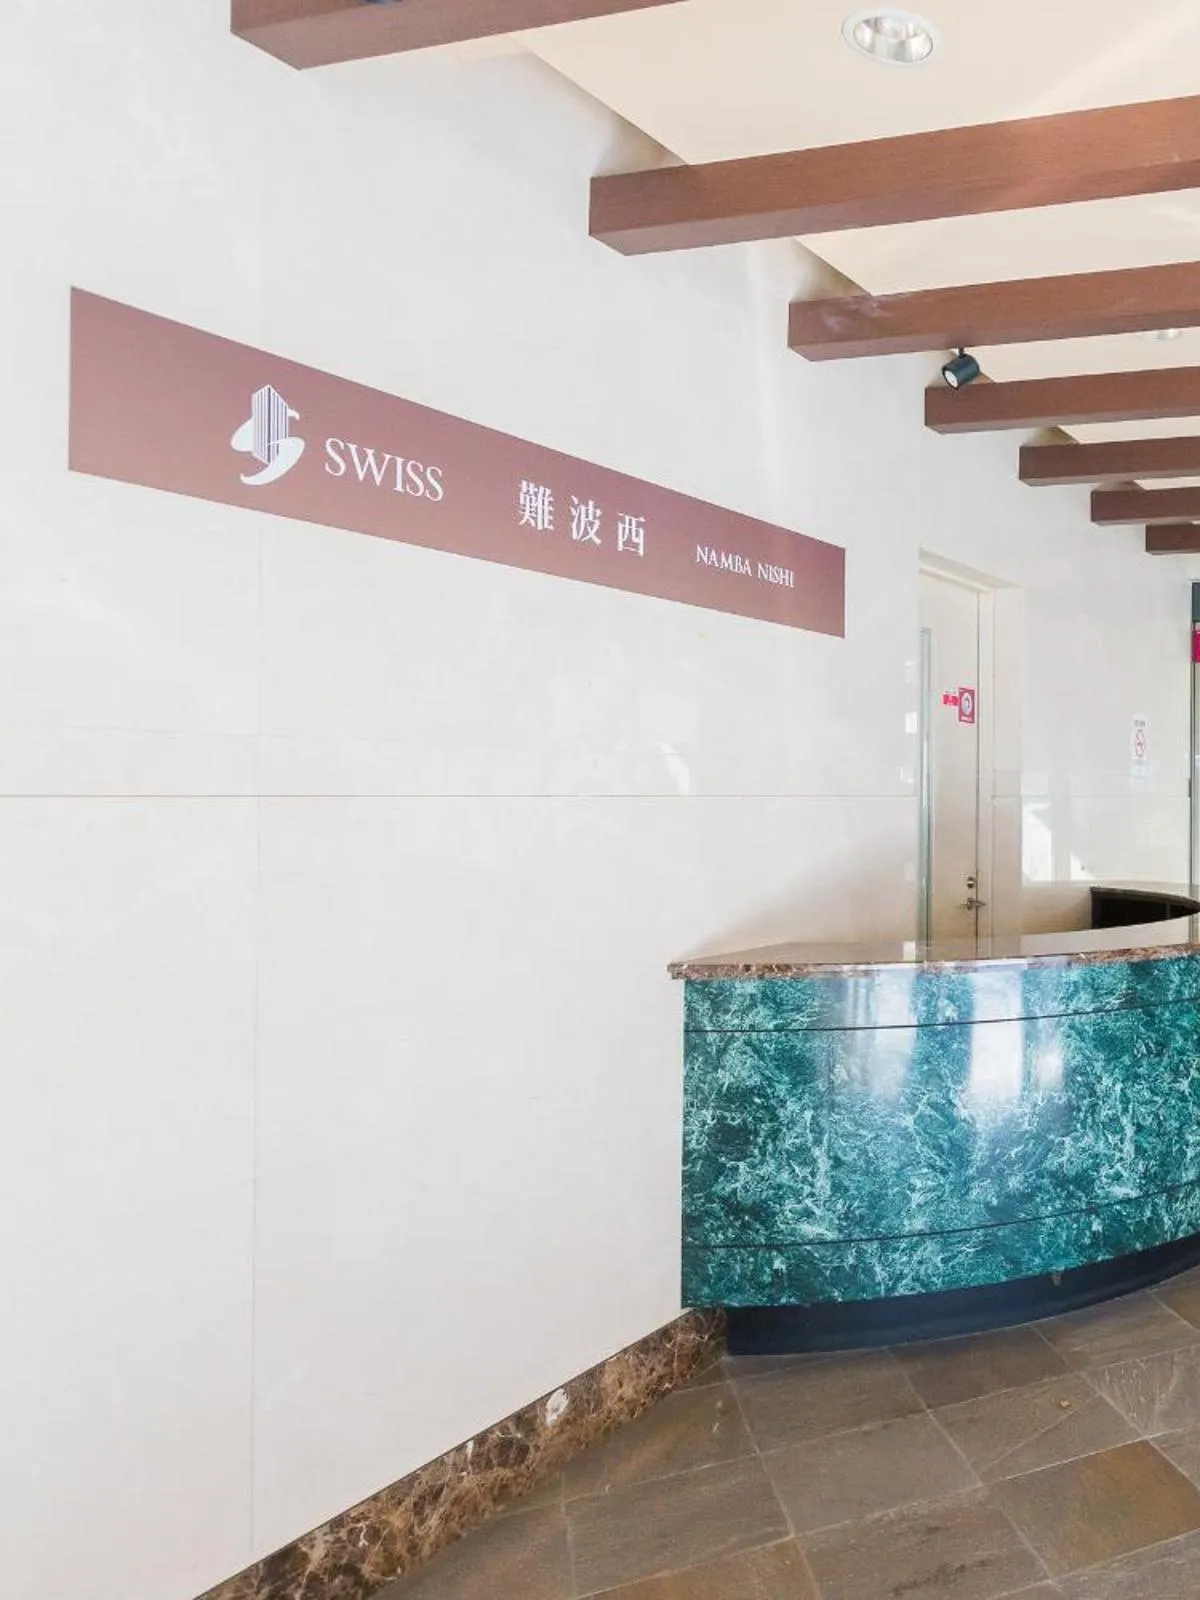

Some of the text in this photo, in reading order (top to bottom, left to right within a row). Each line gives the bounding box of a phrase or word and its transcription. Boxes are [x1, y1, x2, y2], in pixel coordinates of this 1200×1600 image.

[324, 437, 444, 502] SWISS
[518, 479, 647, 557] 難波西
[696, 544, 795, 588] NAMBA NISHI
